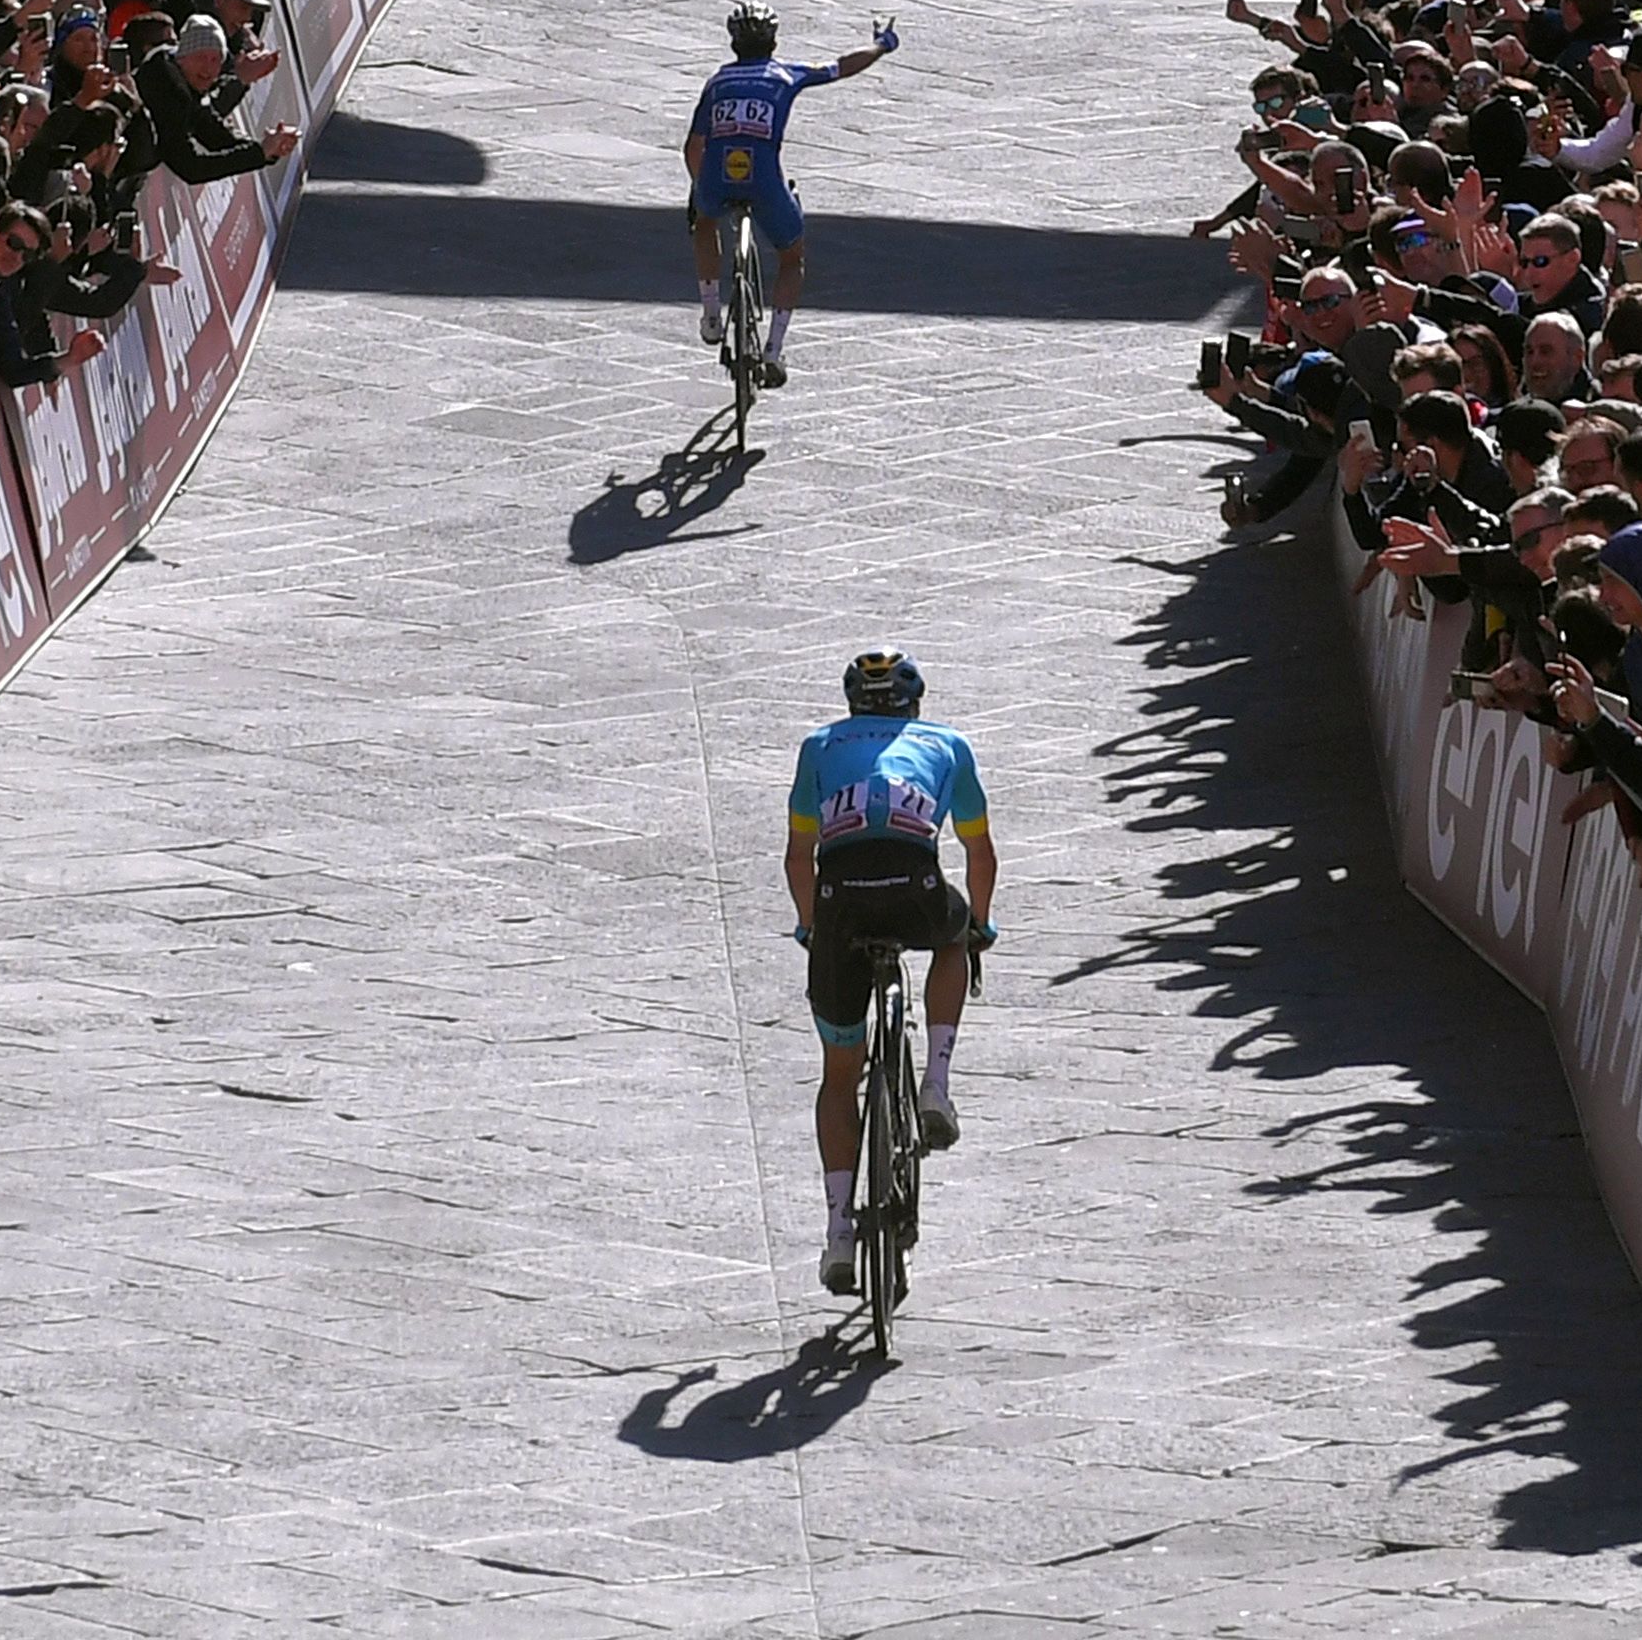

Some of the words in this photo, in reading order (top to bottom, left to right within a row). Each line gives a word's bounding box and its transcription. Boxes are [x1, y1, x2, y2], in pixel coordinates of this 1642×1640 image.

[715, 100, 737, 121] 62
[745, 100, 769, 122] 62
[1427, 700, 1555, 955] enel
